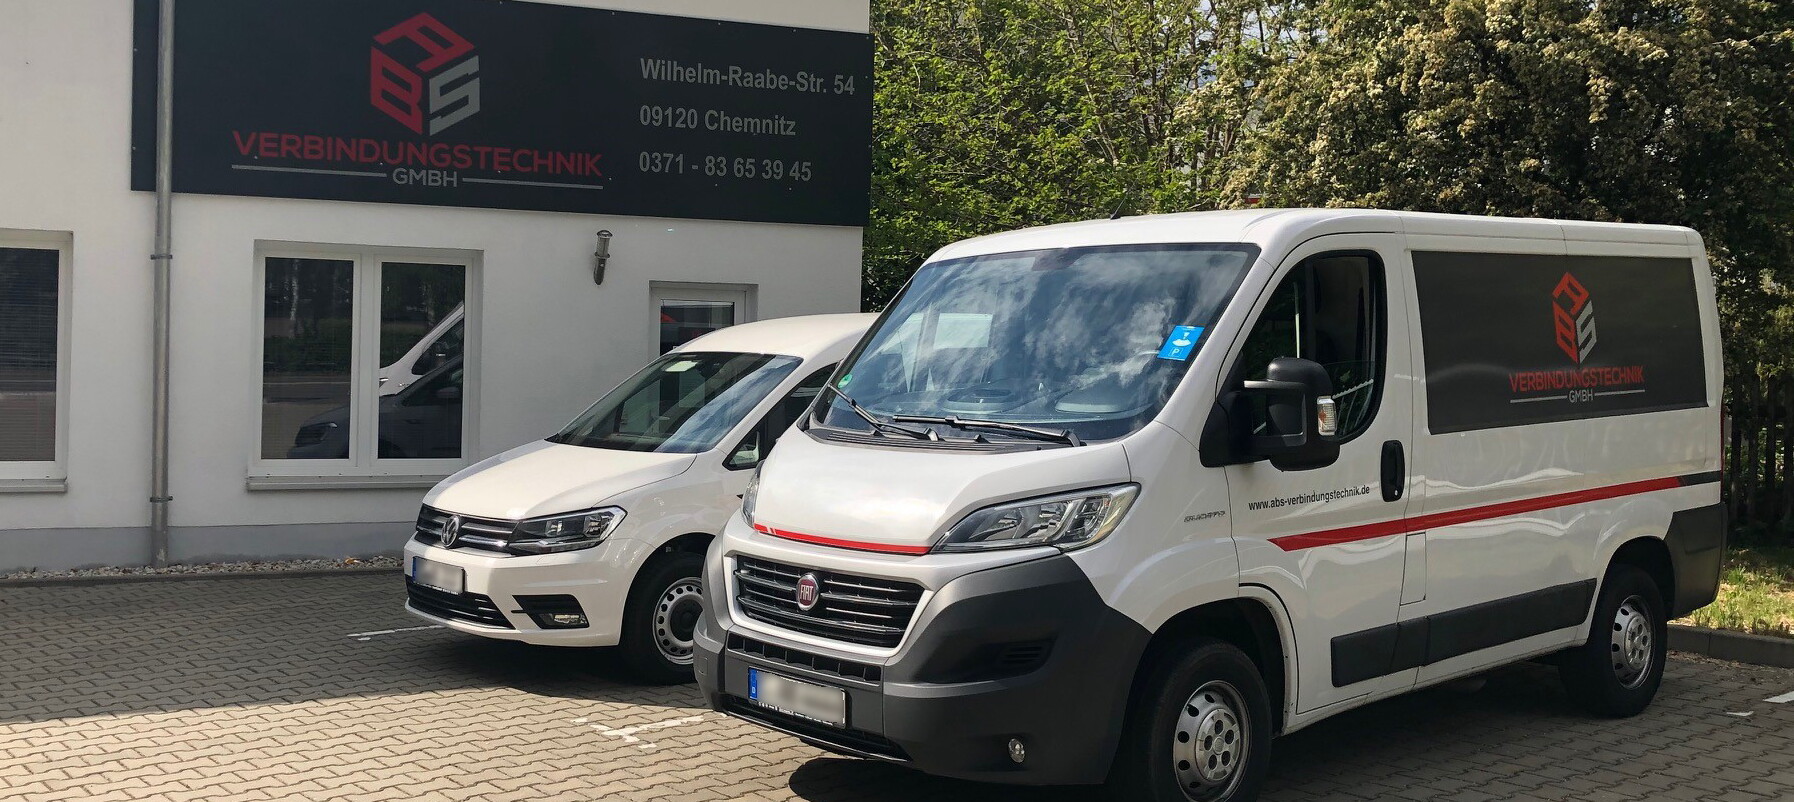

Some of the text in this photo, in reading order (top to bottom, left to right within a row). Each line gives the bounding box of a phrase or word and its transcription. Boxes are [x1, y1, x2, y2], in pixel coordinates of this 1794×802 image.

[370, 12, 480, 136] ABS
[640, 58, 856, 95] Wilhelm-Raabe-Str. 54
[639, 105, 796, 136] 09120 Chemnitz
[232, 130, 603, 177] VERBINDUNGSTECHNIK
[639, 151, 684, 174] 0371
[705, 156, 727, 177] 83
[733, 158, 756, 179] 65
[761, 159, 784, 180] 39
[789, 161, 812, 181] 45
[392, 167, 458, 187] GMBH
[1509, 366, 1645, 393] VERBINDUNGSTECHNIK
[1569, 388, 1594, 403] GMBH
[1248, 485, 1370, 510] www.abs-verbindungstechnik.de
[800, 584, 814, 601] FIAT
